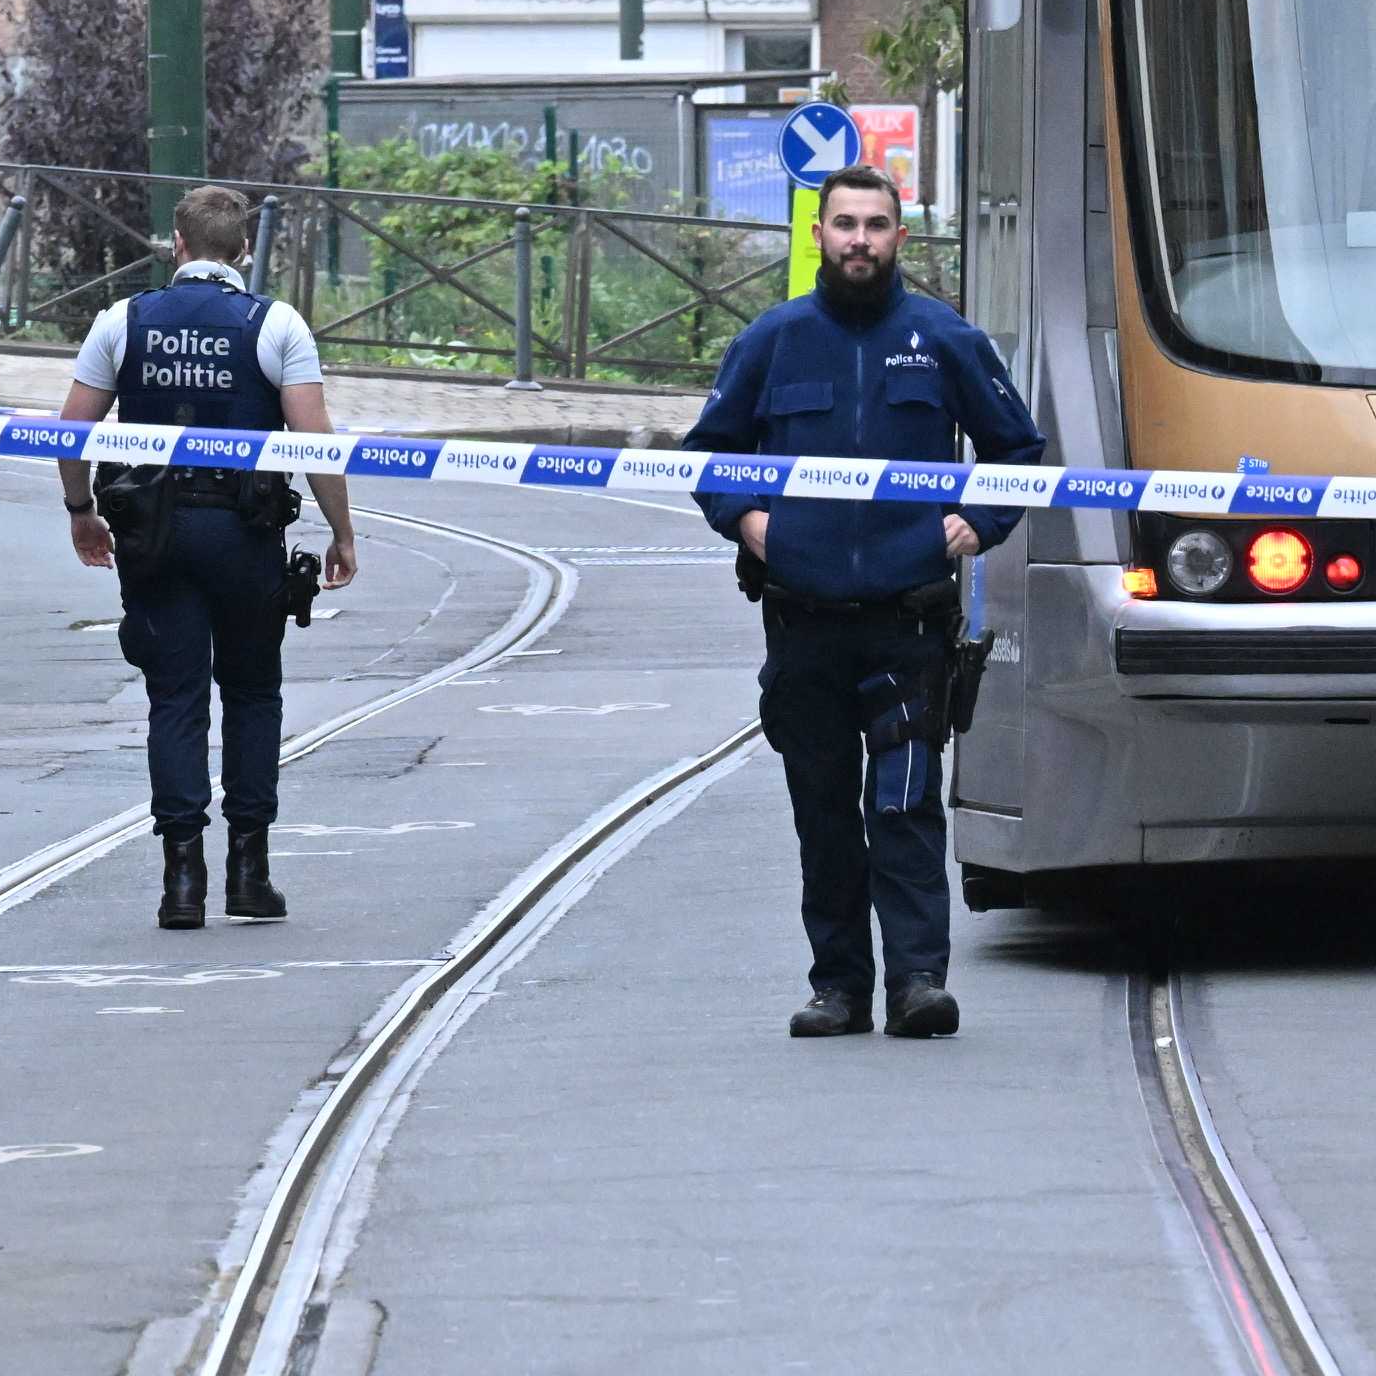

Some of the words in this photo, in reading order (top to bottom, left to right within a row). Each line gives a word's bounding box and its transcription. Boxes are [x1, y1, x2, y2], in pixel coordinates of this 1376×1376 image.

[146, 328, 230, 356] Police
[885, 354, 913, 368] Police
[142, 360, 233, 389] Politie
[11, 428, 57, 445] Police
[97, 433, 148, 451] Politie
[186, 439, 233, 456] Police
[271, 443, 324, 461] Politie
[362, 448, 408, 466] Police
[447, 452, 499, 470] Politie
[538, 456, 584, 473] Police
[623, 460, 675, 477] Politie
[713, 464, 760, 482] Police
[799, 468, 852, 486] Politie
[890, 471, 937, 489] Police
[976, 475, 1029, 493] Politie
[1067, 479, 1115, 496] Police
[1154, 482, 1207, 500] Politie
[1246, 485, 1294, 503] Police
